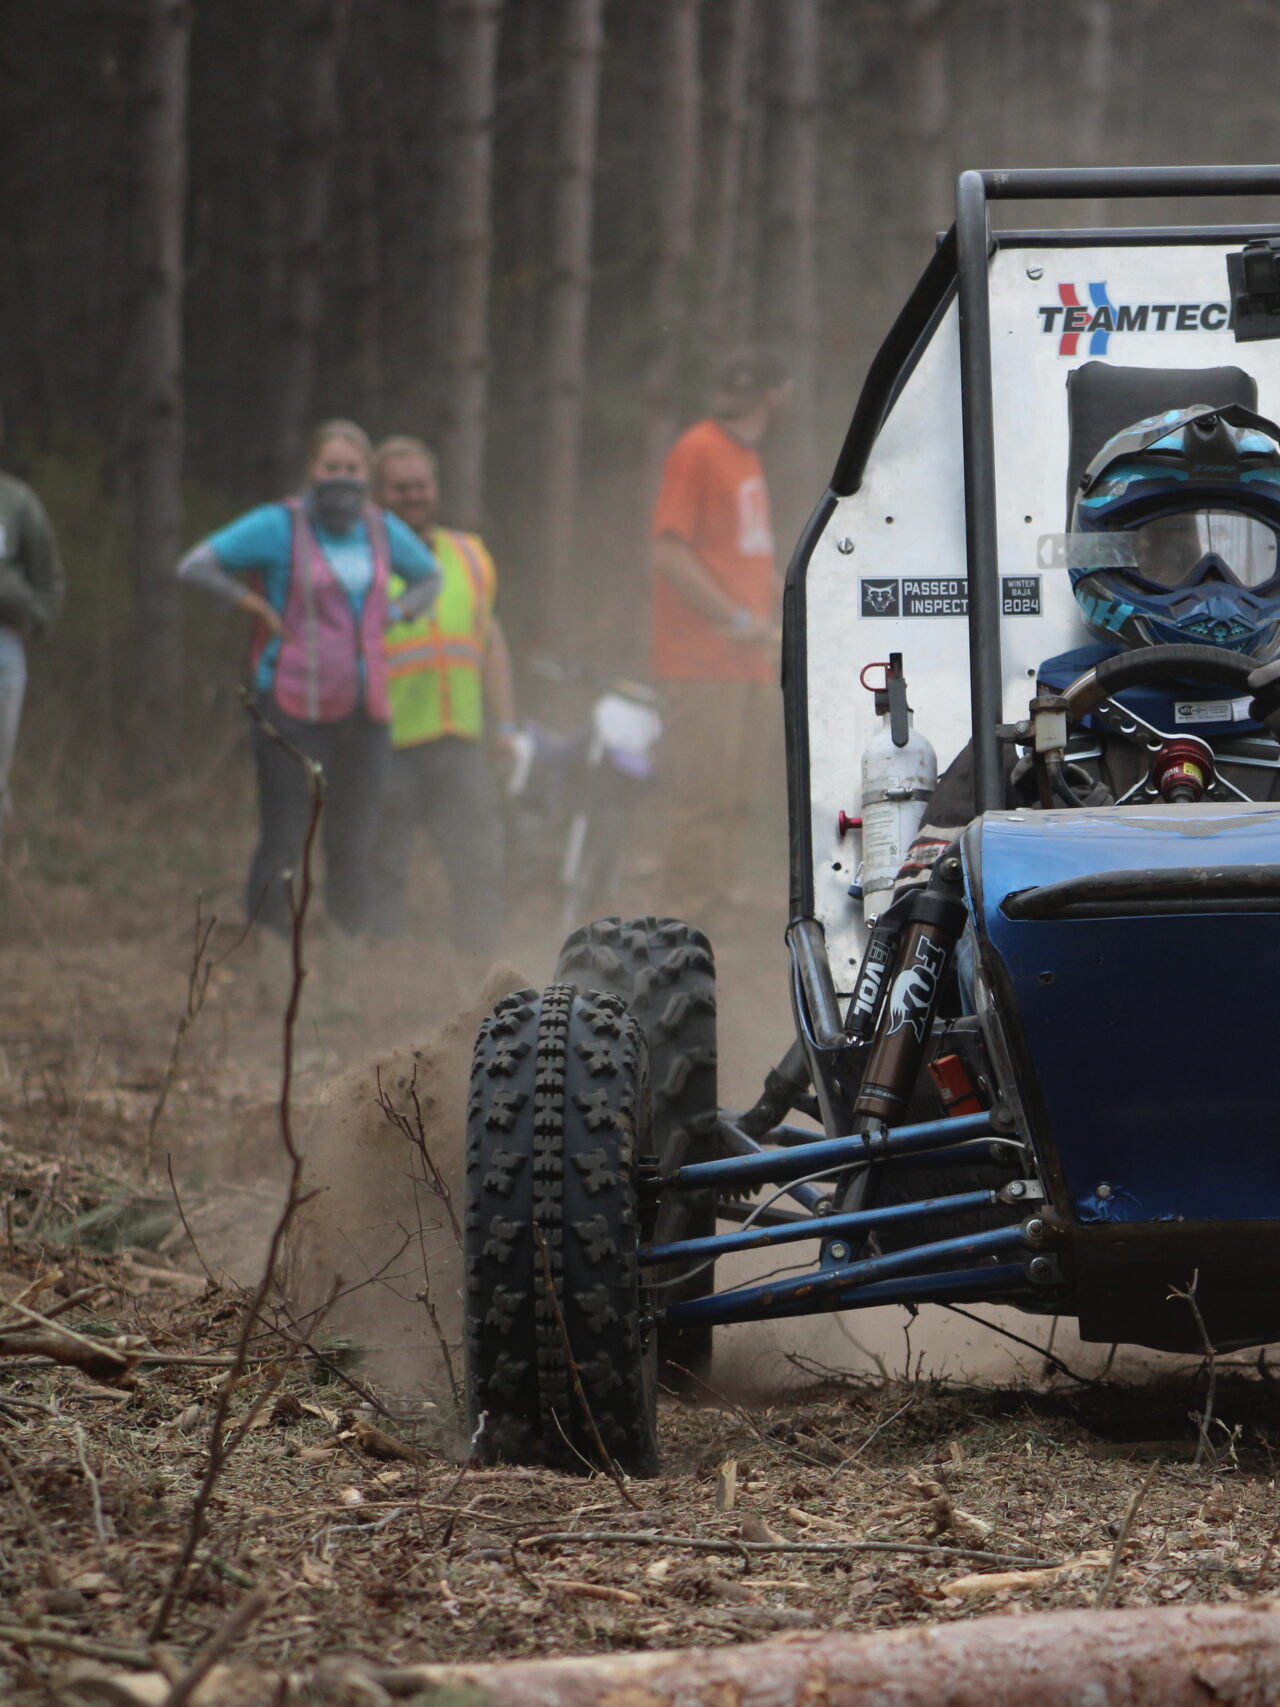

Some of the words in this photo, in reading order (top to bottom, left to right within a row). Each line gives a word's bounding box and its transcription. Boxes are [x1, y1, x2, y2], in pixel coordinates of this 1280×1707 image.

[904, 581, 958, 596] PASSED
[961, 581, 969, 595] T
[1007, 579, 1036, 588] WINTER
[1011, 588, 1032, 596] BAJA
[910, 599, 969, 614] INSPECT
[1003, 599, 1040, 613] 2024
[854, 939, 890, 1015] EVOL
[886, 934, 946, 1044] FOX
